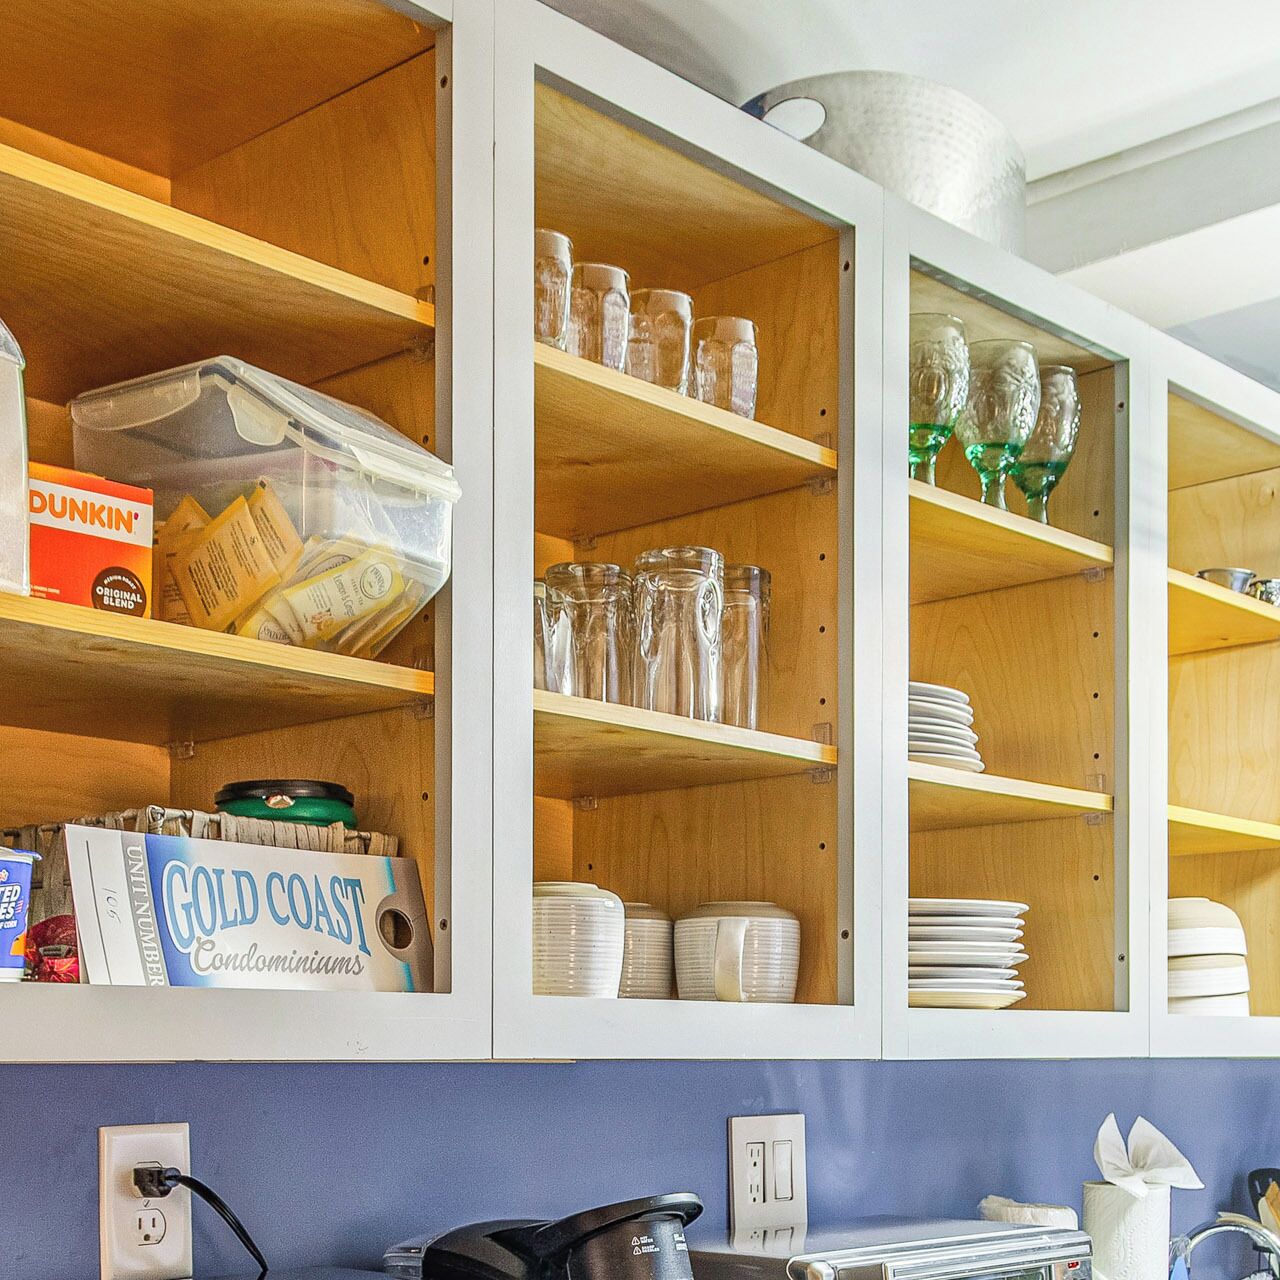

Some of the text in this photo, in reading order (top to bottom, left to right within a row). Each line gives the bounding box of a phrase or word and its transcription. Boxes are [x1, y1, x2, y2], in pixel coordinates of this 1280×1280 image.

[29, 488, 140, 534] DUNKIN'
[96, 586, 143, 603] ORIGINAL
[103, 596, 135, 610] BLEND
[126, 845, 165, 987] UNIT NUMBER
[166, 863, 372, 957] GOLD COAST
[193, 936, 365, 976] Condominiums
